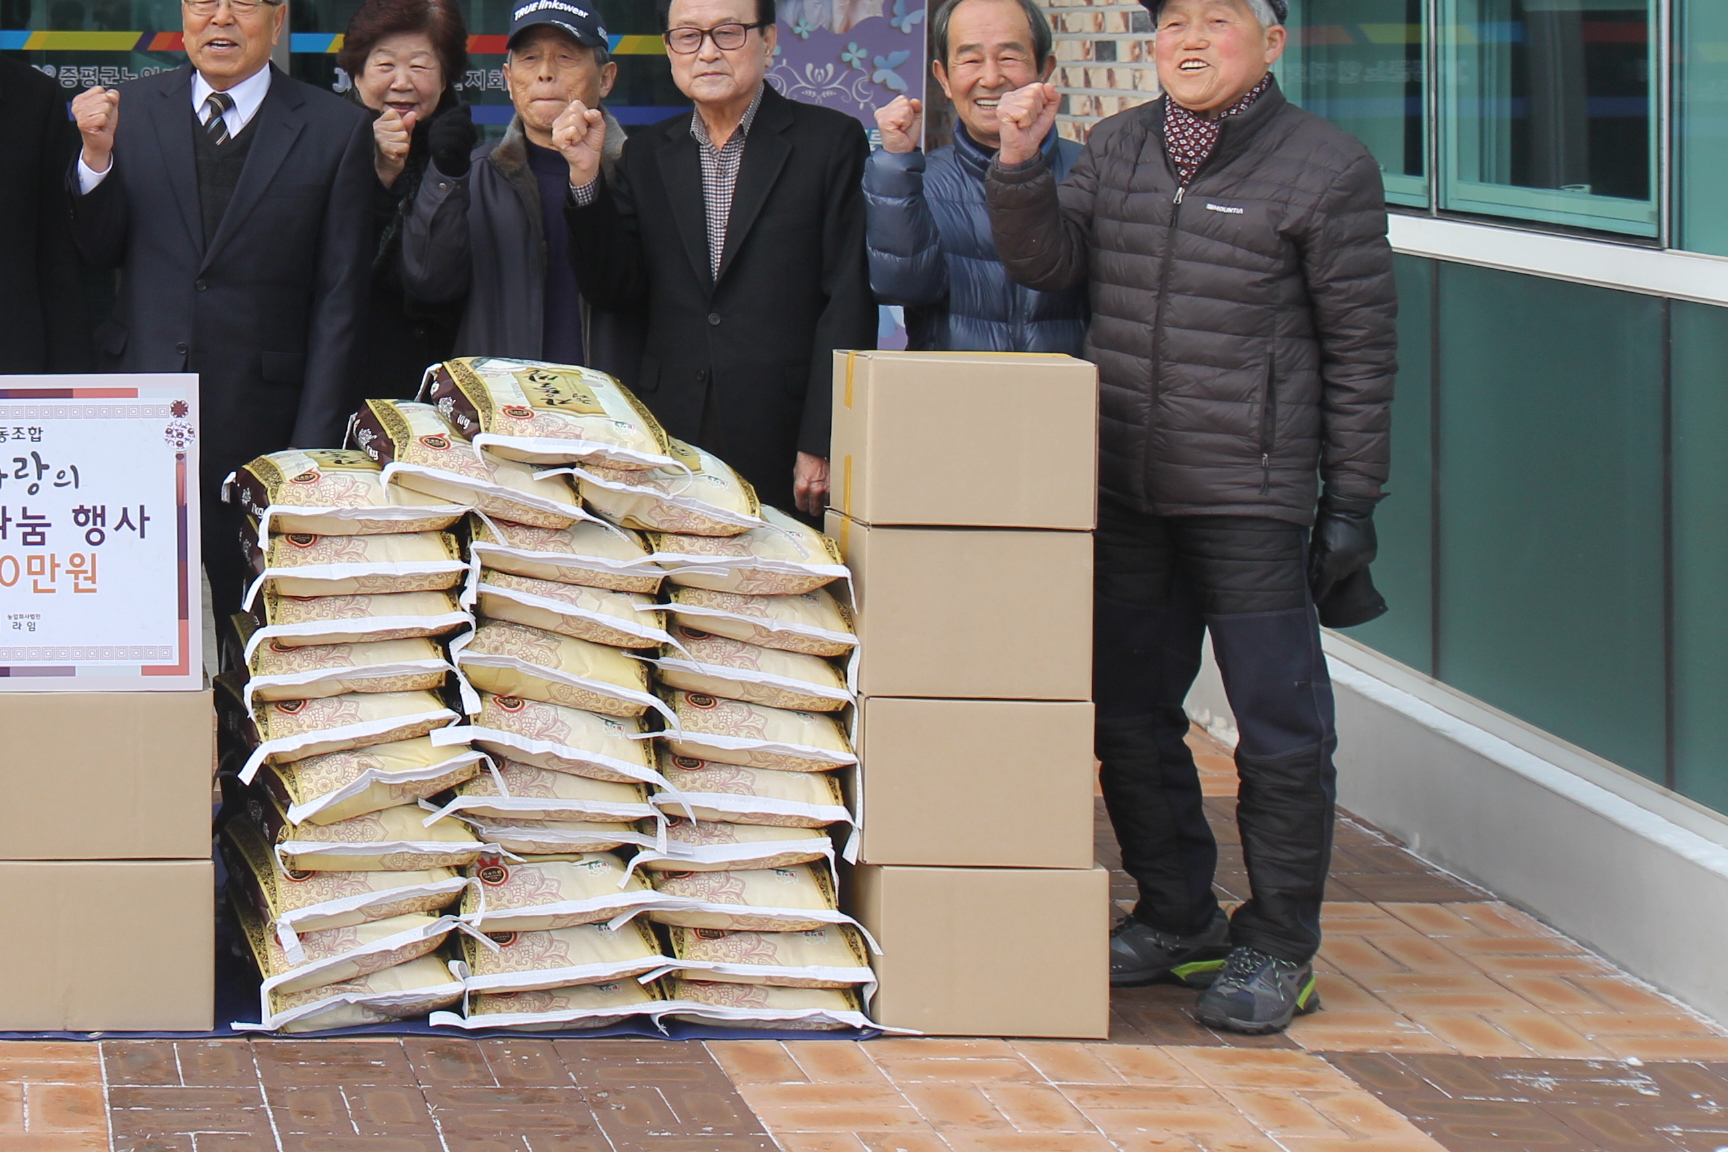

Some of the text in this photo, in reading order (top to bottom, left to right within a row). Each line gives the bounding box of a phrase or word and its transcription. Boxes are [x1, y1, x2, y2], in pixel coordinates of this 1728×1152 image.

[514, 0, 589, 21] TRUE linkswear
[72, 504, 151, 547] 행사
